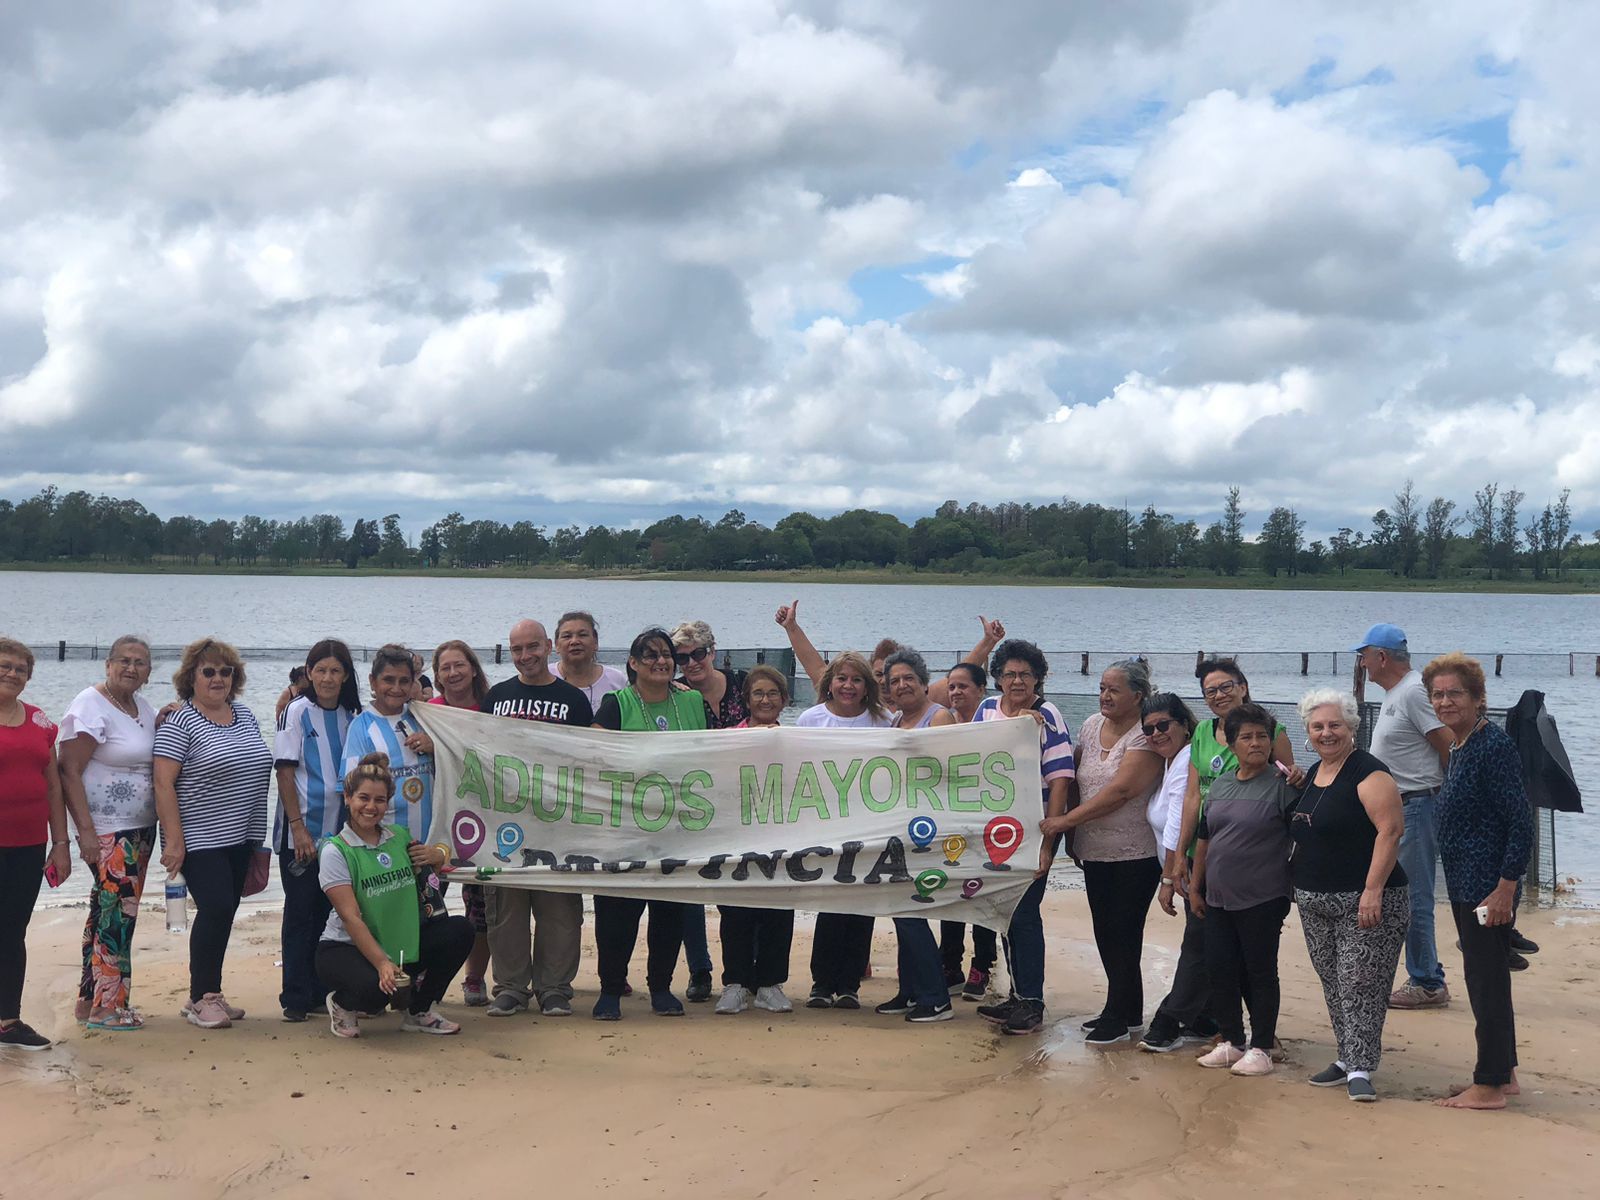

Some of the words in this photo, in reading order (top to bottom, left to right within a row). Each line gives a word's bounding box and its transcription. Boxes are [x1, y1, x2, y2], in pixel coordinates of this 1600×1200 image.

[493, 699, 569, 721] HOLLISTER
[455, 749, 715, 832] ADULTOS
[739, 751, 1015, 825] MAYORES
[520, 836, 914, 884] INCIA
[361, 866, 412, 891] MINISTERIO
